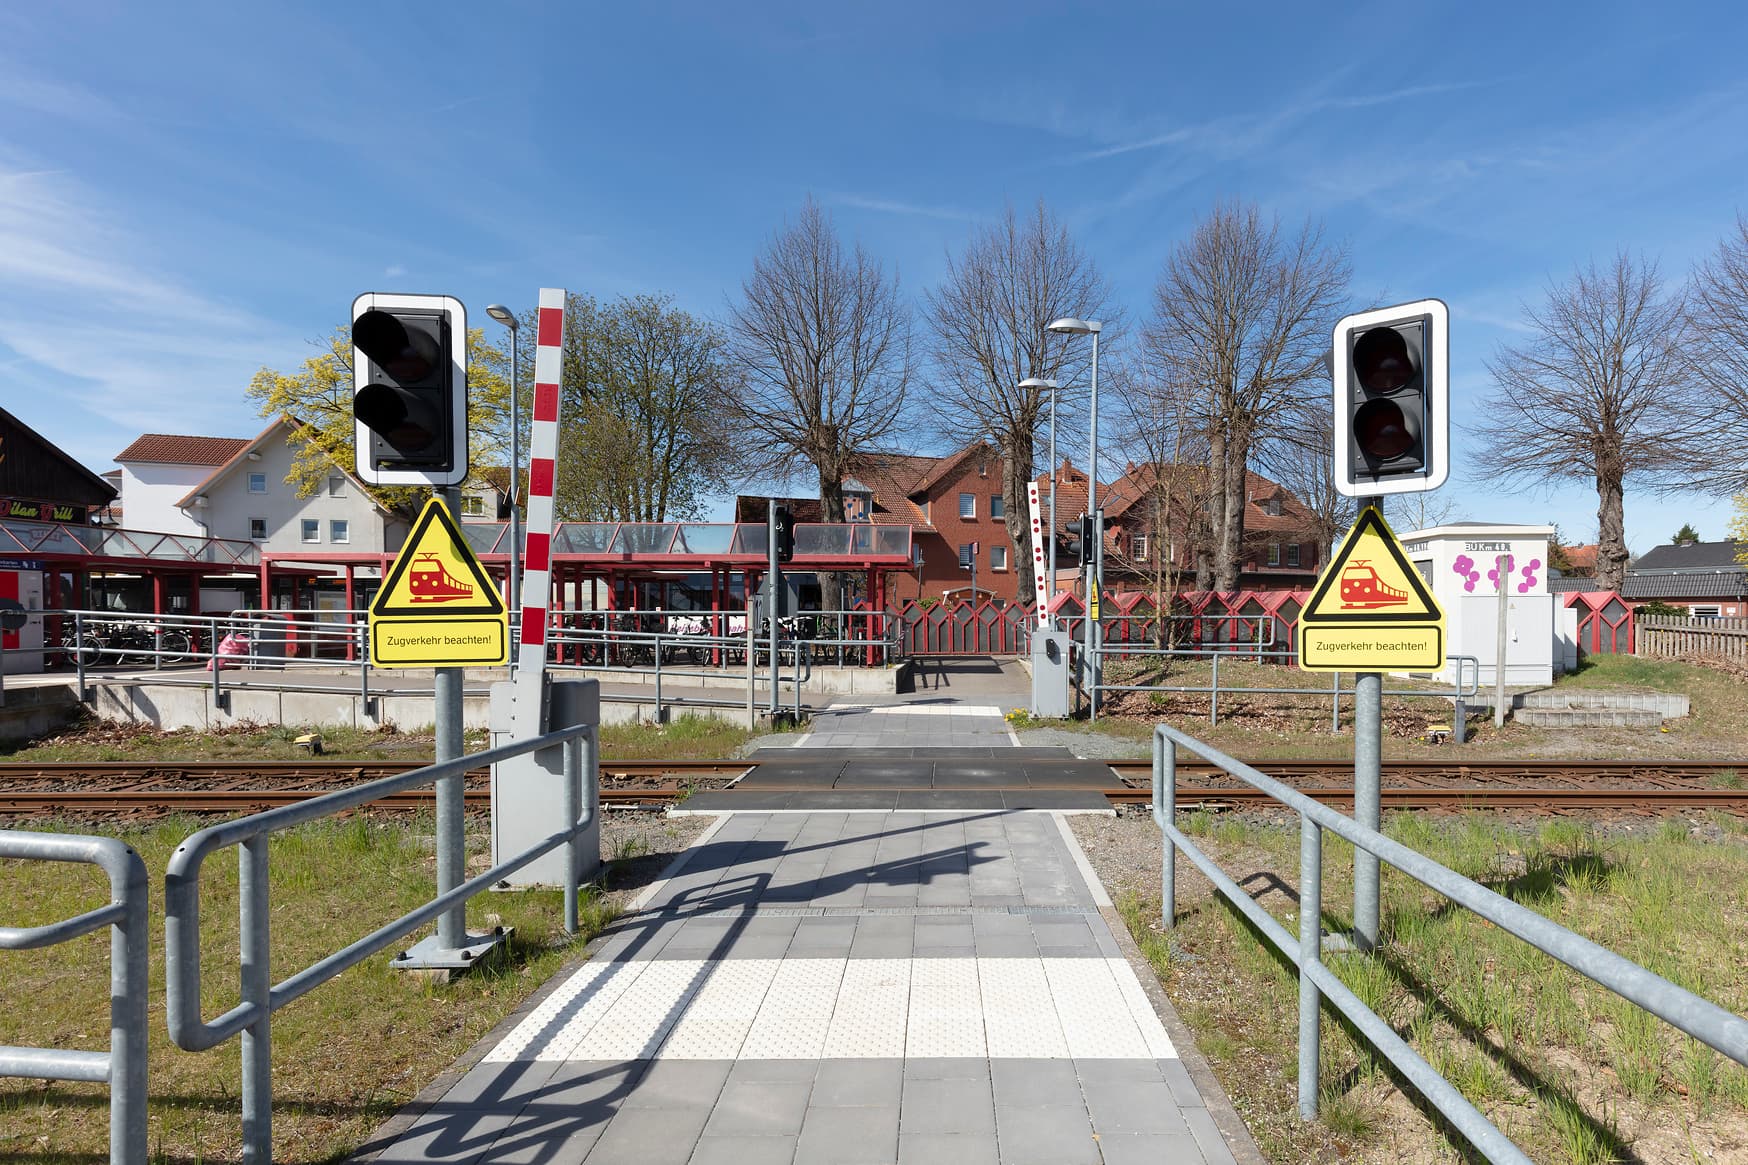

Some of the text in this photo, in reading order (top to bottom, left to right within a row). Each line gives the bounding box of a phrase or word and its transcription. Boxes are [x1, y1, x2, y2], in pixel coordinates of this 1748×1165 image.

[387, 635, 492, 648] Zugverkehr beachten!
[1316, 641, 1427, 653] Zugverkehr beachten!
